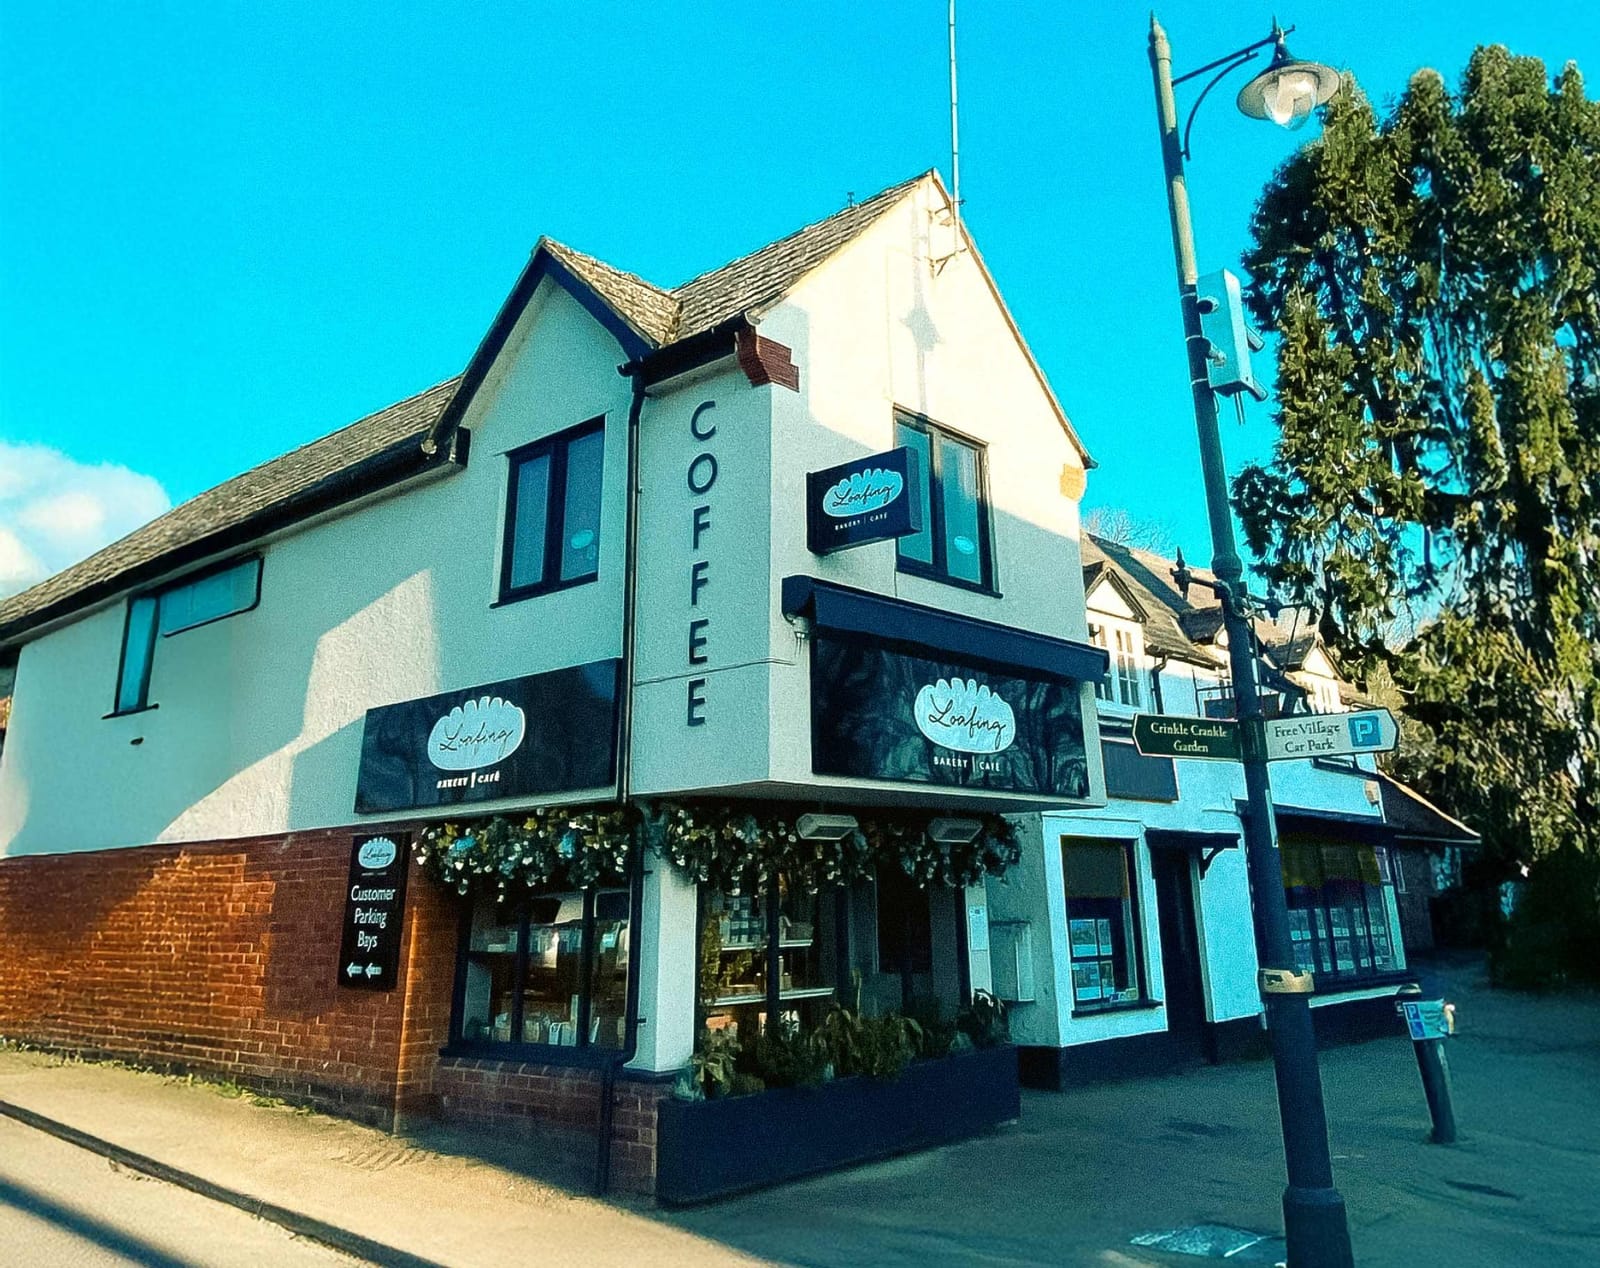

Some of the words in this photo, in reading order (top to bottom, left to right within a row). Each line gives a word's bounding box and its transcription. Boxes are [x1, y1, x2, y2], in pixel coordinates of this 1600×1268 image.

[832, 484, 895, 507] Loafing
[687, 400, 718, 726] COFFEE
[928, 694, 1007, 750] Loafing
[1150, 722, 1189, 736] Crinkle
[1190, 724, 1228, 737] Crankle
[1274, 725, 1298, 737] Free
[1298, 721, 1340, 736] Village
[440, 722, 514, 760] Loafing
[1173, 740, 1209, 752] Garden
[1285, 742, 1305, 752] Car
[1307, 738, 1335, 751] Park
[933, 756, 968, 768] BAKERY
[351, 885, 396, 901] Customer
[354, 907, 387, 929] Parking
[357, 930, 378, 952] Bays
